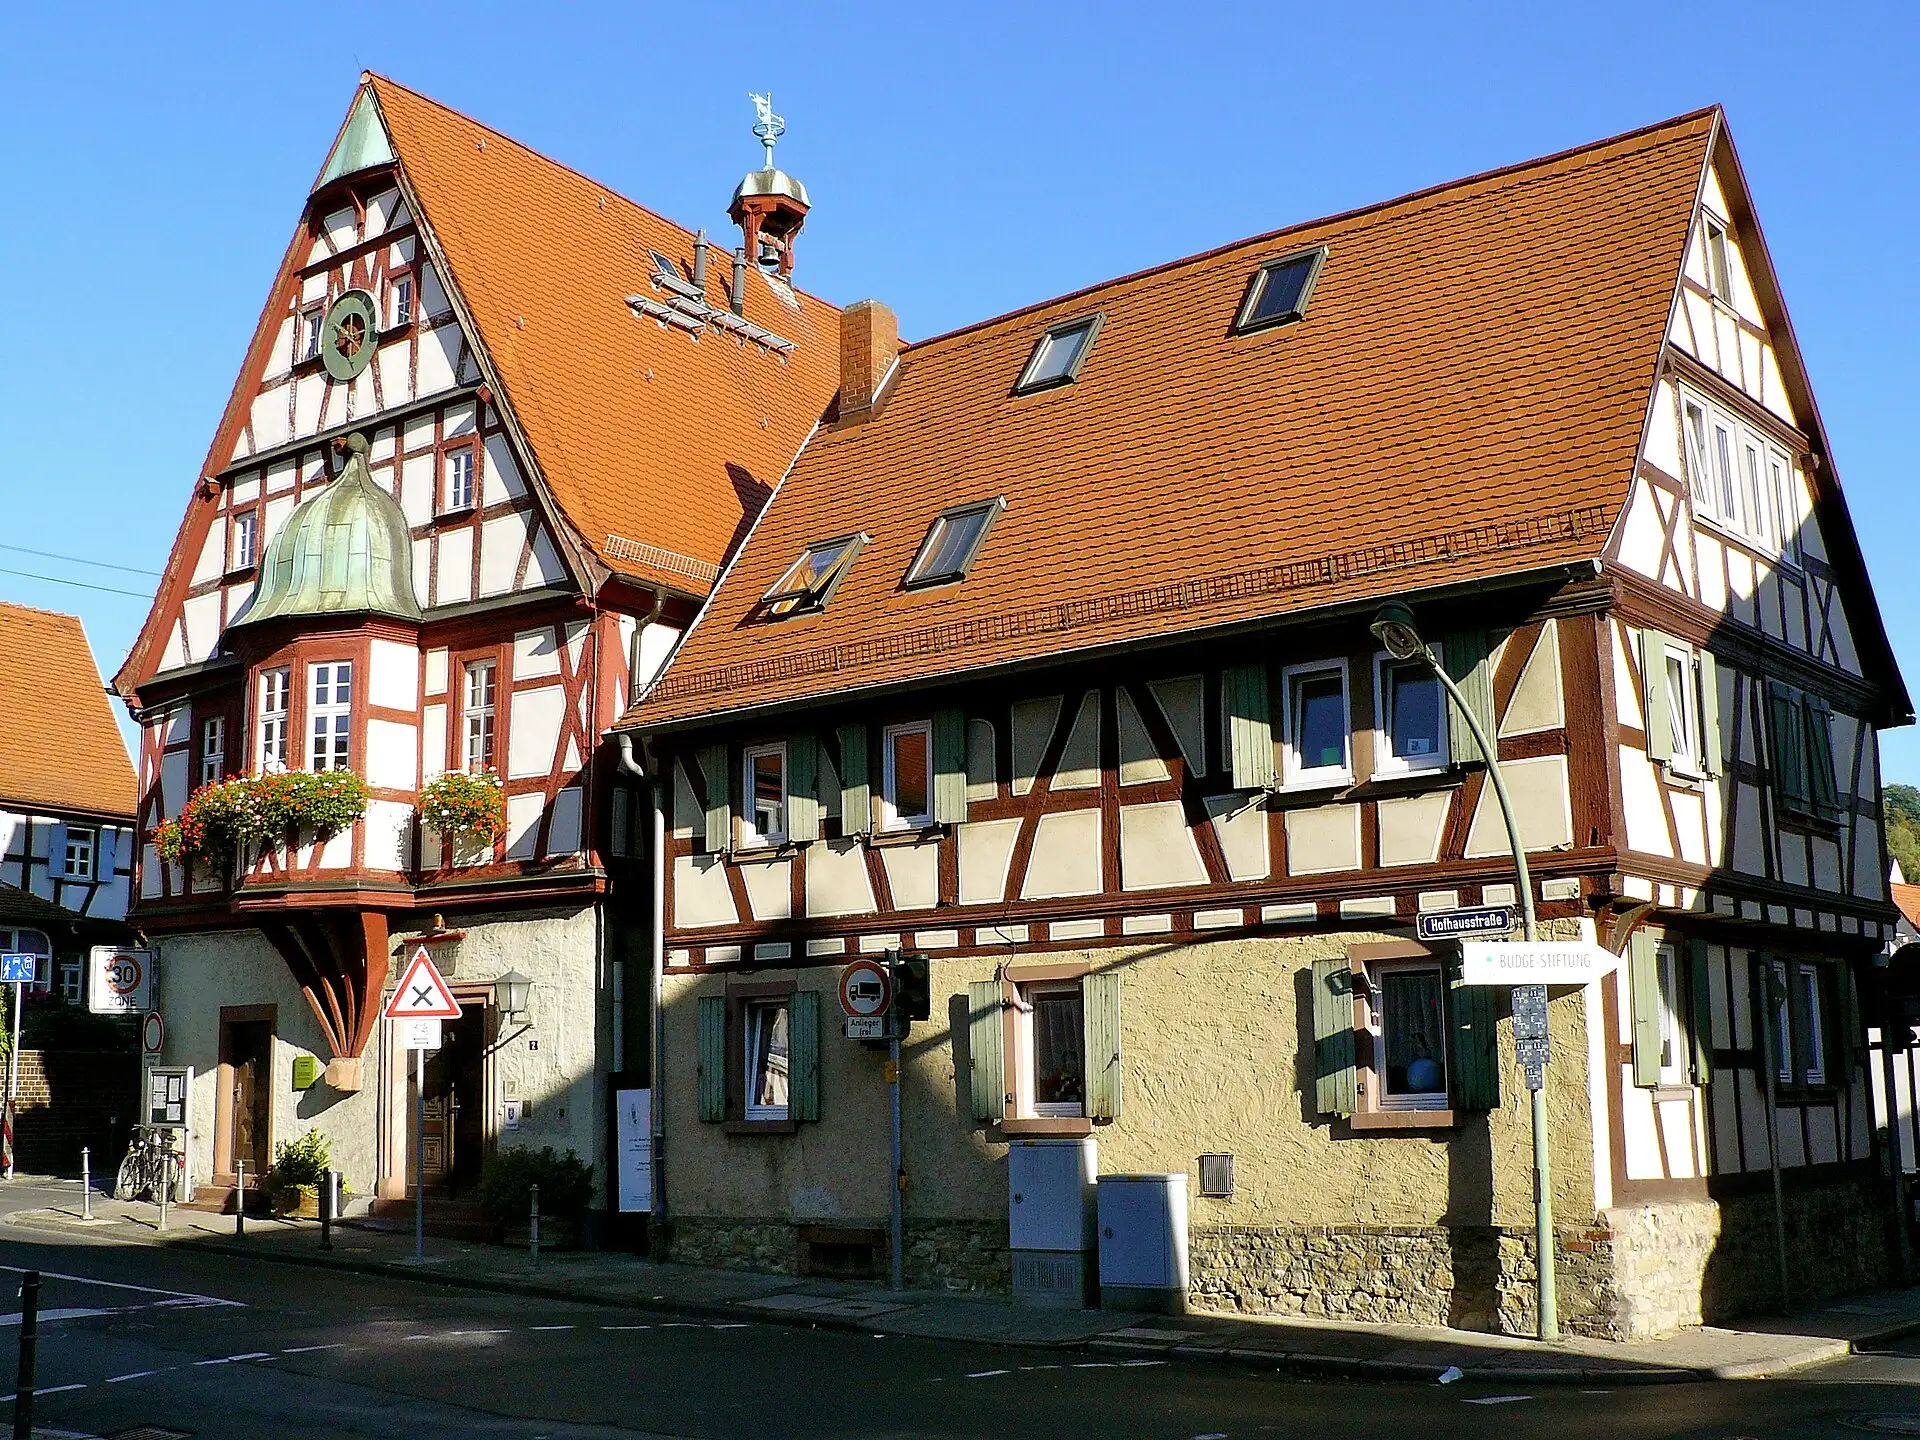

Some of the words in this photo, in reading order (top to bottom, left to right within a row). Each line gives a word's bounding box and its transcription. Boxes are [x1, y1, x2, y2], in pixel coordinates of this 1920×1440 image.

[1431, 914, 1503, 932] Hofhausstraße
[1500, 953, 1591, 968] BUDGE-STIFTUNG
[112, 966, 134, 983] 30
[109, 997, 136, 1006] ZONE
[851, 1019, 880, 1029] Anlieger
[860, 1026, 872, 1036] frei
